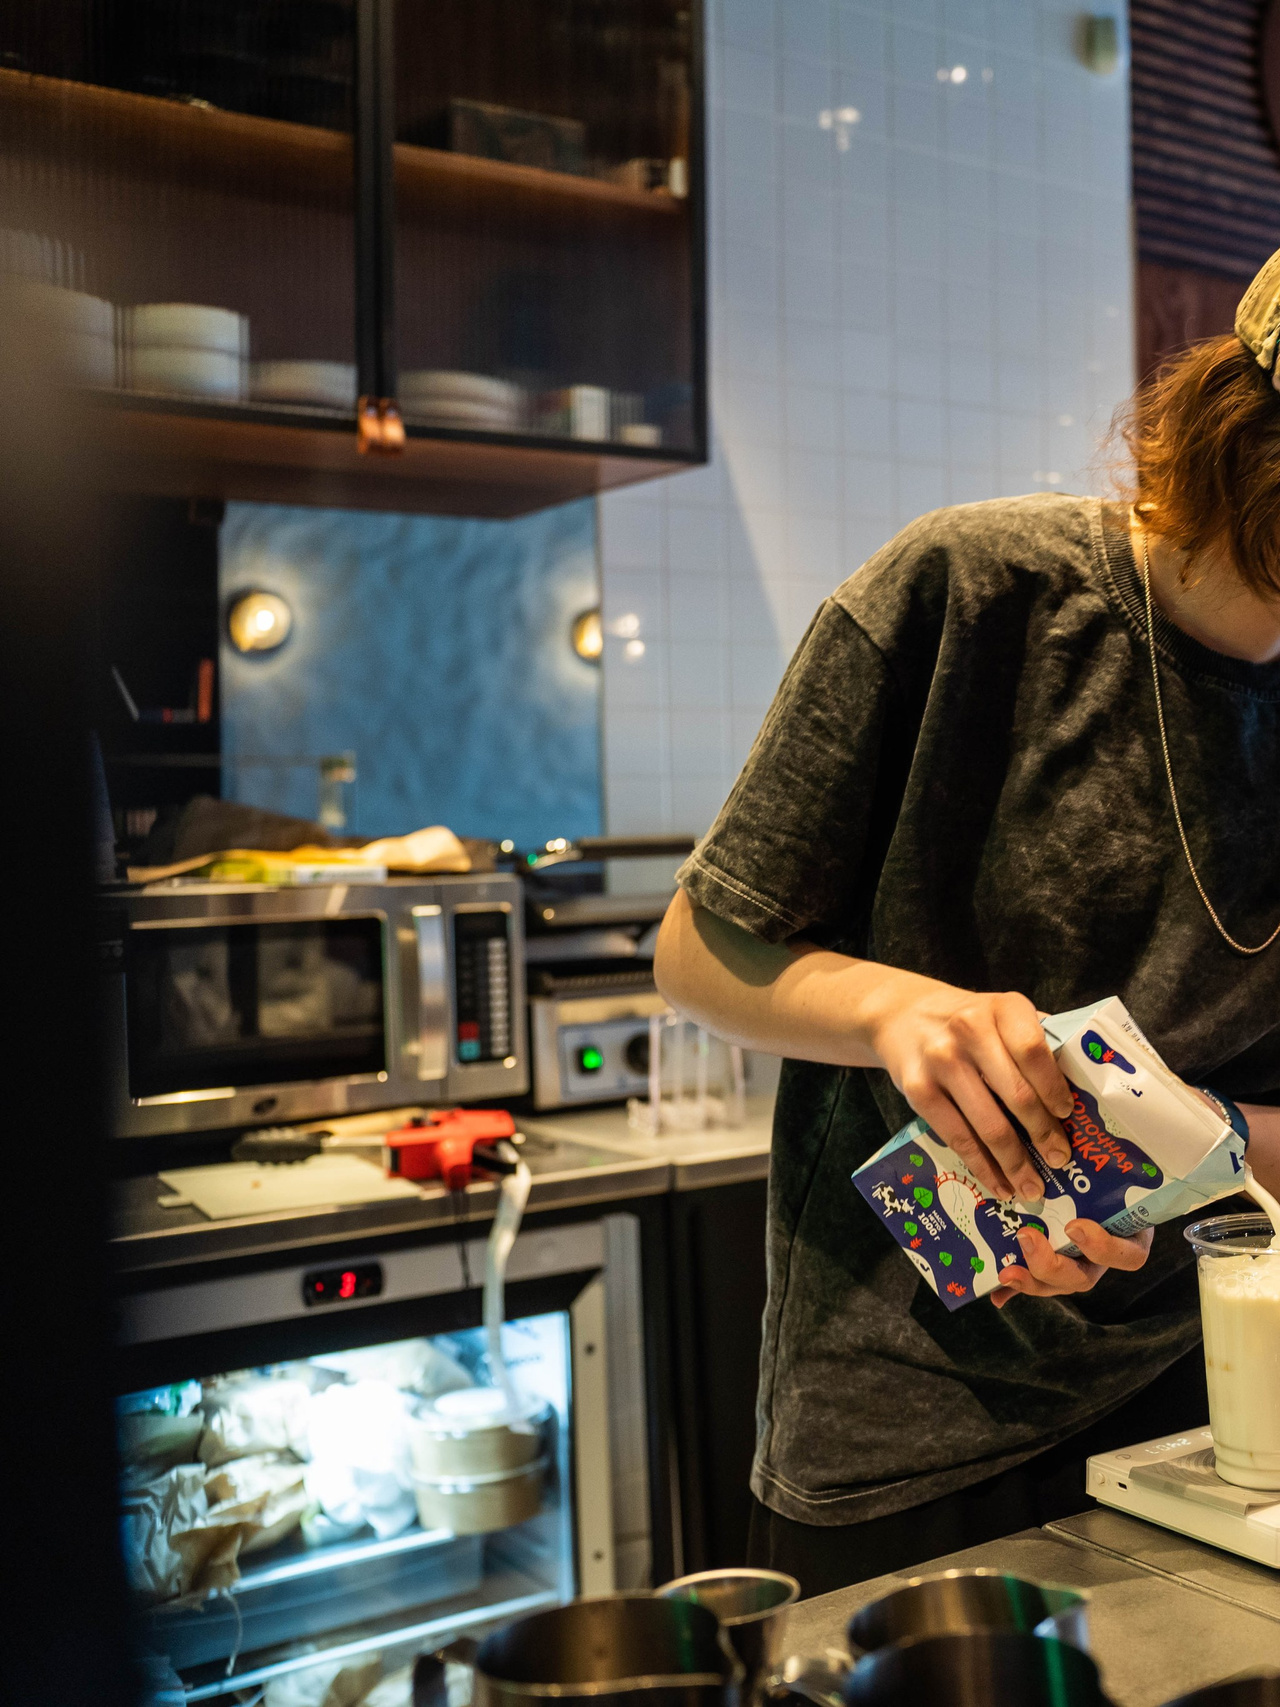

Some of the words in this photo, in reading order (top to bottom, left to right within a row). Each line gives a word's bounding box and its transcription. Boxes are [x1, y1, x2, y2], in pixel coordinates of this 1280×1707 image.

[1063, 1119, 1111, 1173] ЕЧКА
[1072, 1092, 1134, 1174] ОЛОЧНАЯ
[917, 1212, 938, 1237] 1000
